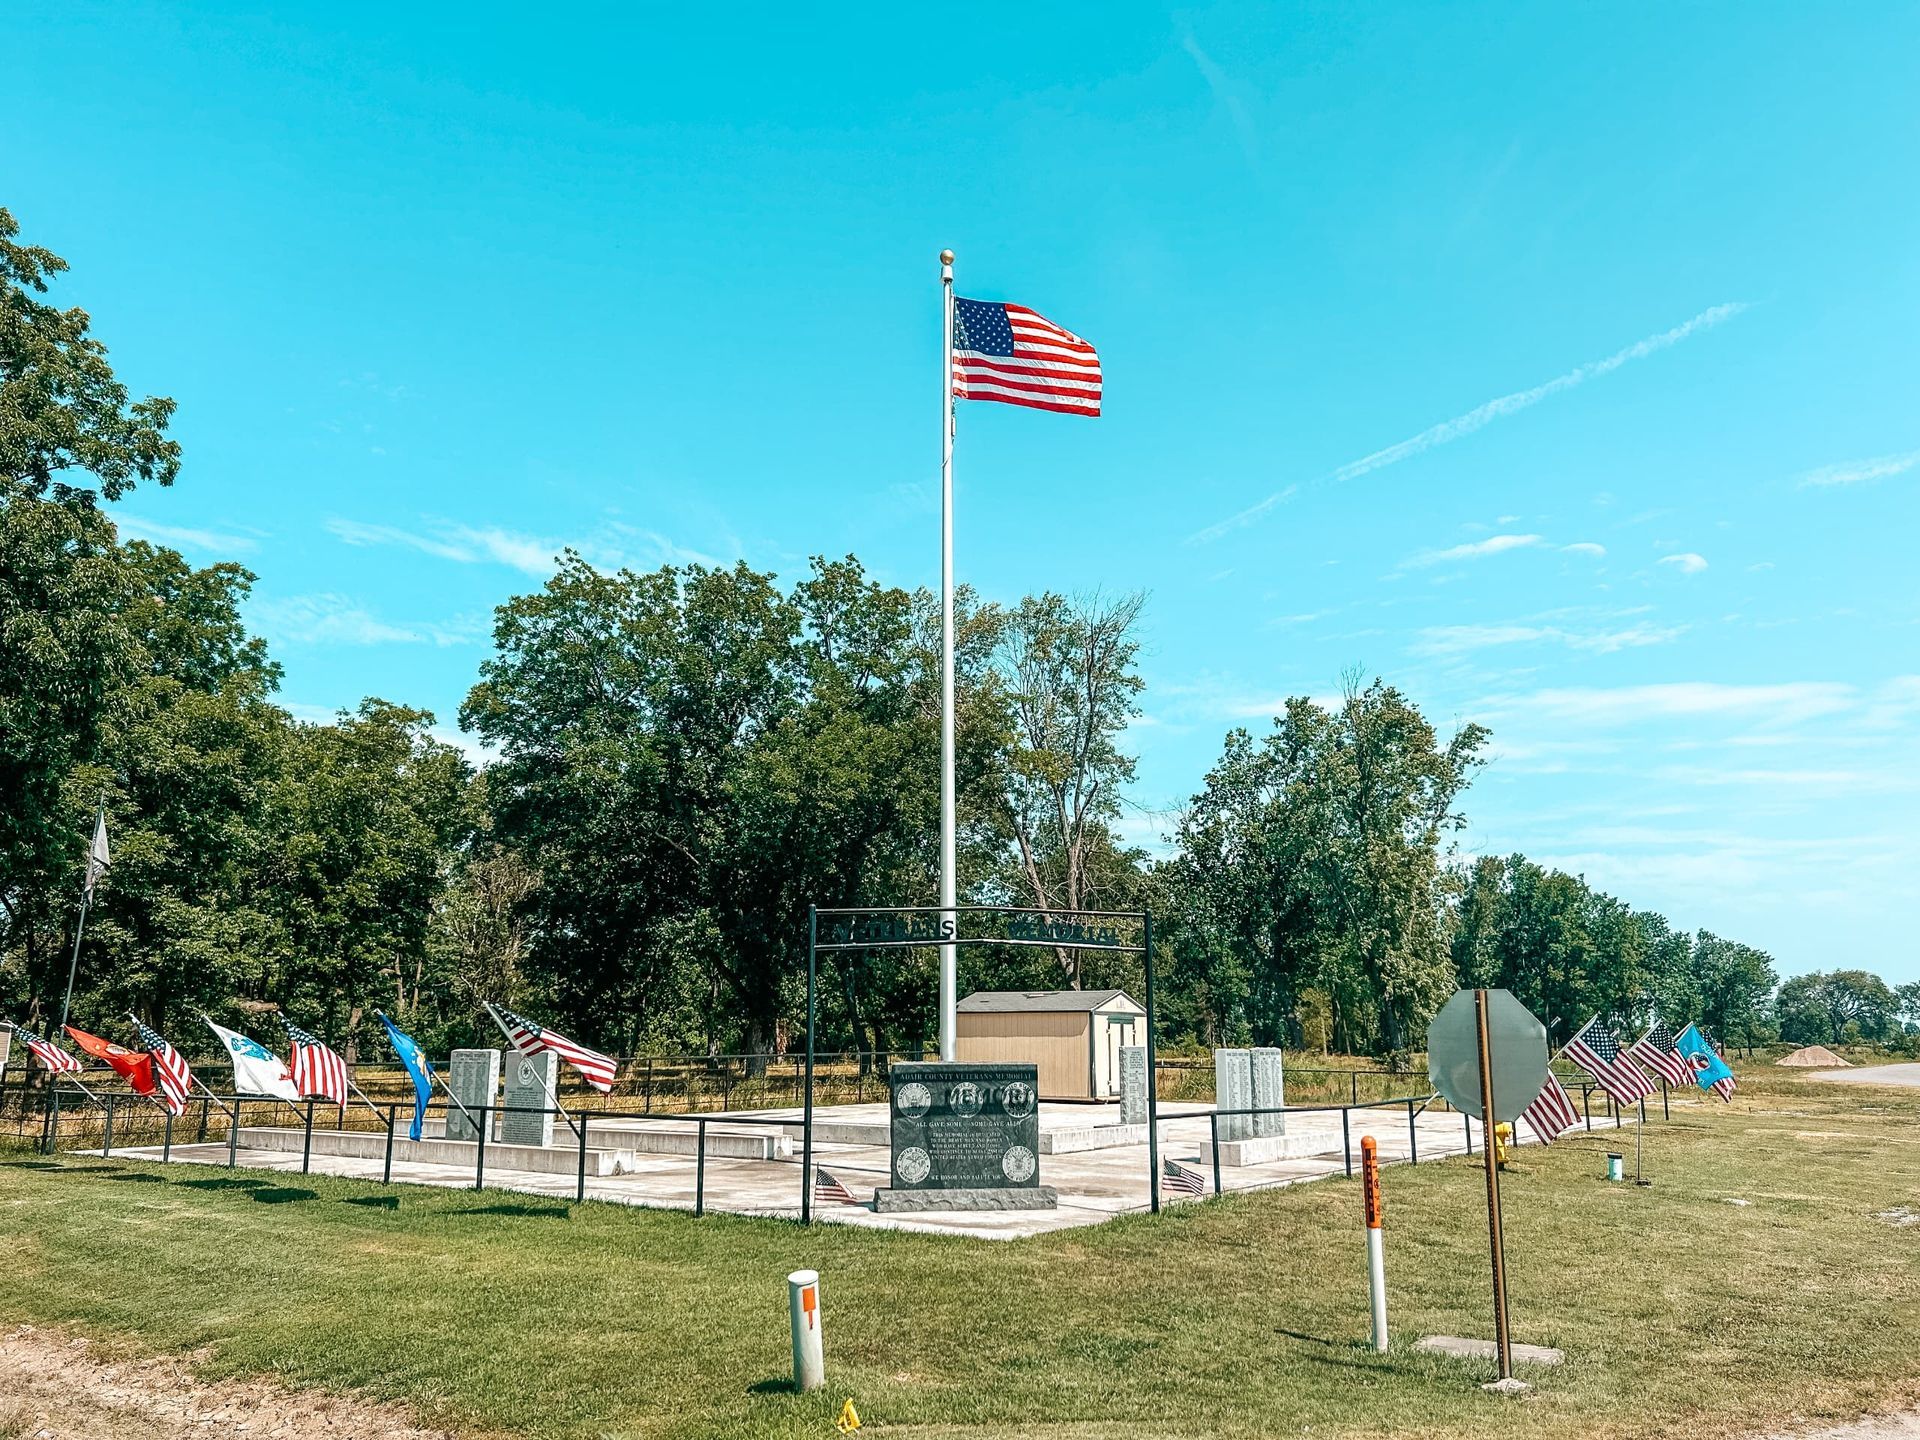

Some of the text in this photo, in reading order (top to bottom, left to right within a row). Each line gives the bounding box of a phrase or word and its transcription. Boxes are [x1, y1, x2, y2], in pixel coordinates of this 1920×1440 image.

[898, 1084, 930, 1100] UNITED STATES
[898, 1148, 929, 1161] UNITED STATES
